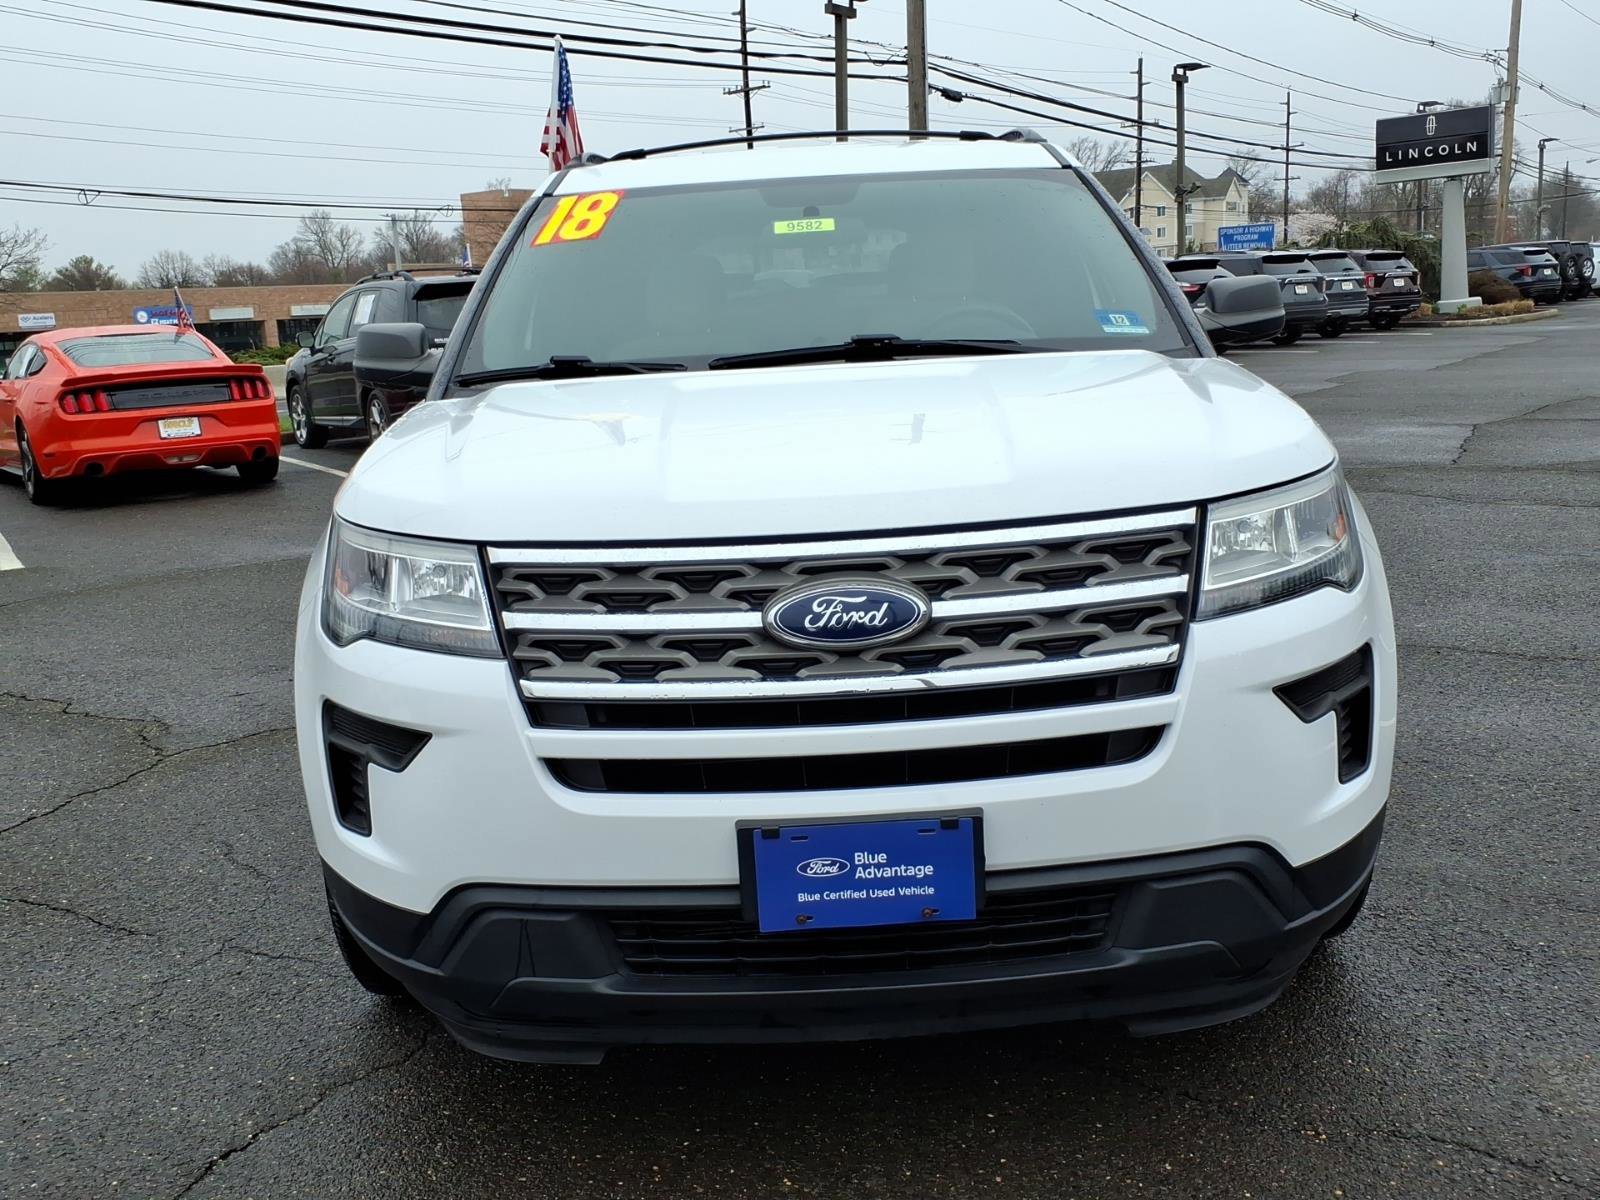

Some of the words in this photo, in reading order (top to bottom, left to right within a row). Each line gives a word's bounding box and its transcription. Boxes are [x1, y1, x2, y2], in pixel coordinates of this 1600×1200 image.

[1385, 141, 1477, 162] LINCOLN
[533, 191, 621, 245] 18
[786, 220, 823, 232] 9582
[1220, 227, 1244, 235] SPONSOR
[1249, 225, 1273, 233] HIGHWAY
[1224, 243, 1243, 251] LITTER
[1243, 241, 1267, 249] REMOVAL
[804, 596, 889, 632] Ford
[854, 851, 887, 865] Blue
[806, 860, 840, 875] Ford
[855, 863, 934, 880] Advantage
[798, 892, 821, 902] Blue
[823, 889, 867, 900] Certified
[869, 887, 895, 898] Used
[898, 885, 935, 896] Vehicle
